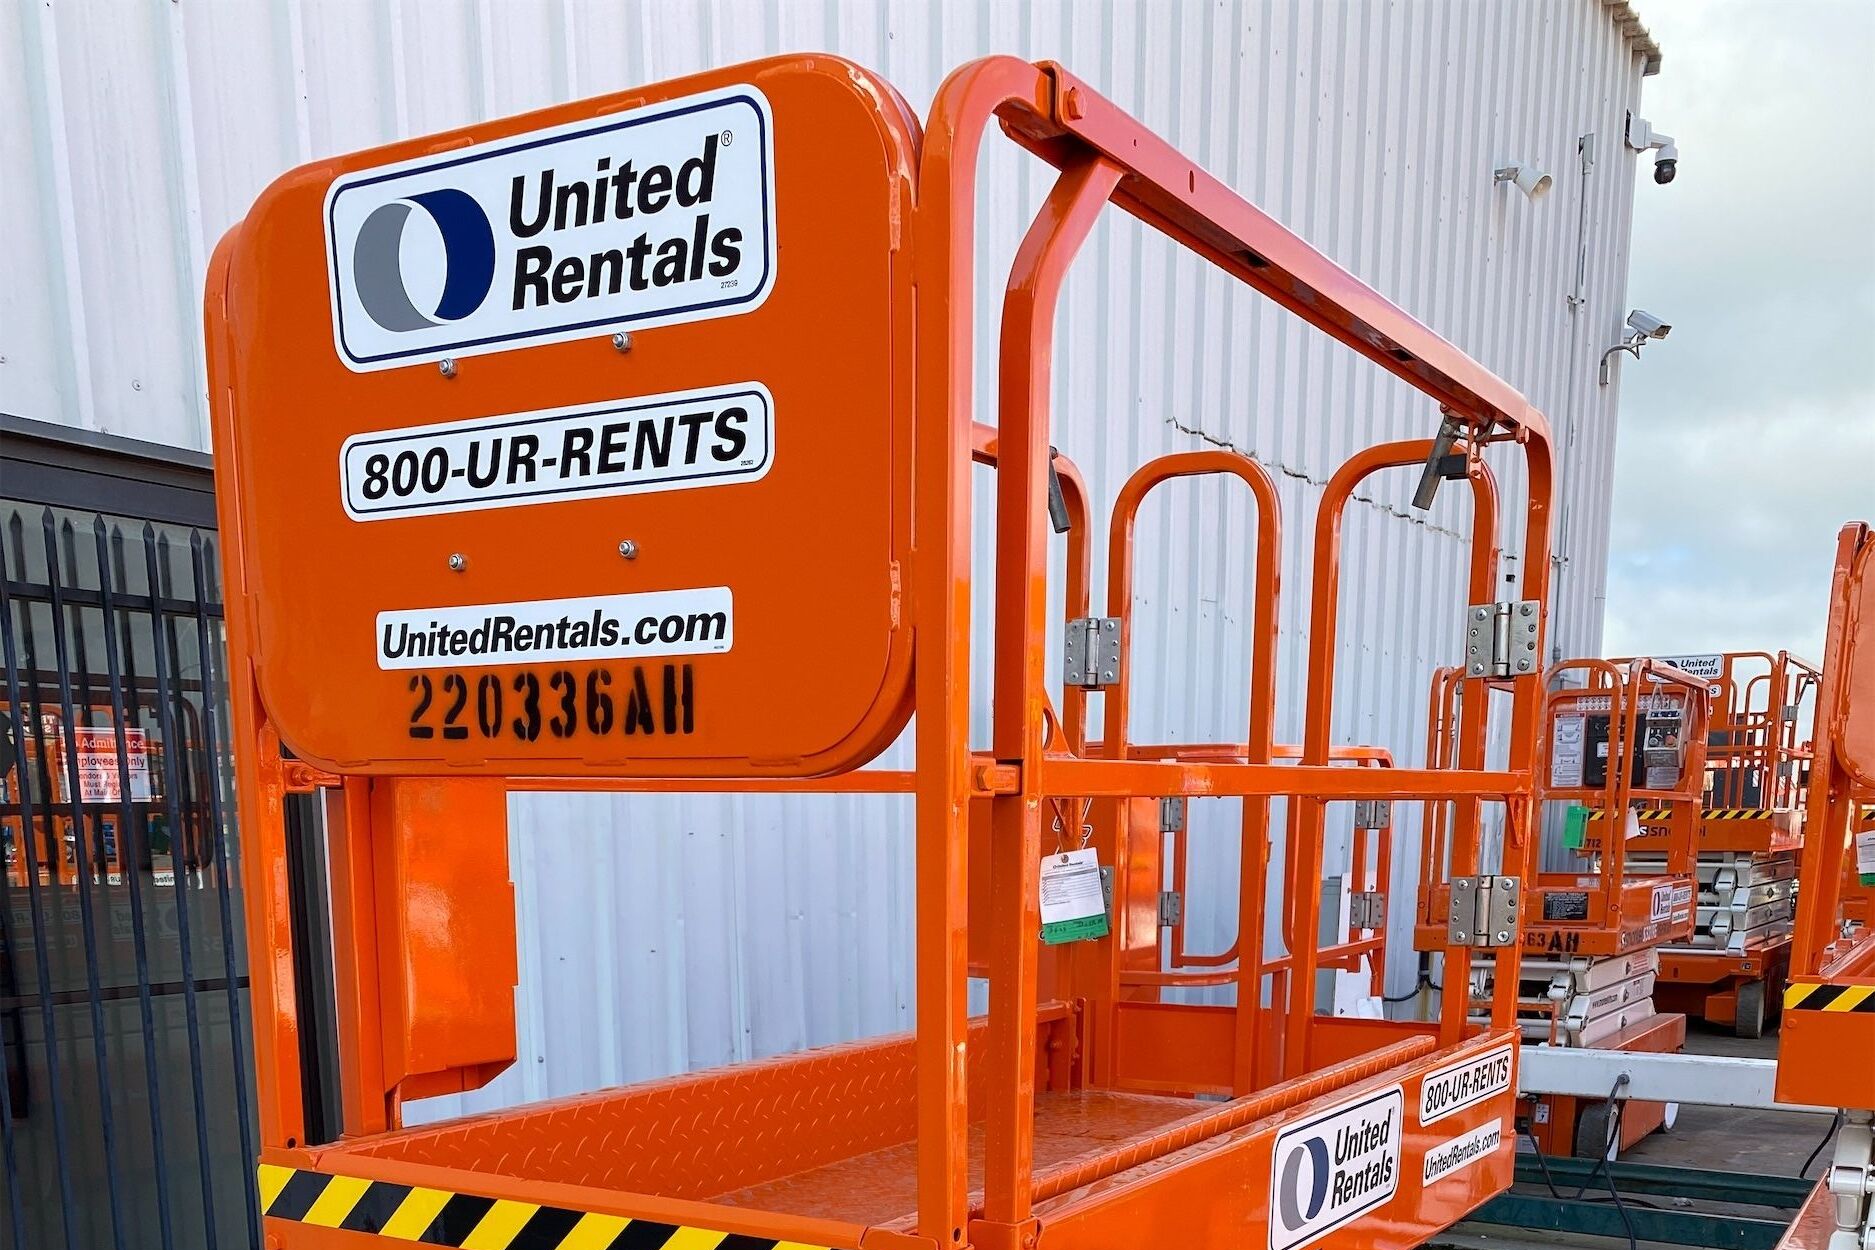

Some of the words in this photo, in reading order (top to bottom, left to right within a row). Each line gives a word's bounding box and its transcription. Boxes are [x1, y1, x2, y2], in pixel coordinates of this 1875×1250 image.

[508, 133, 720, 239] United
[511, 214, 742, 311] Rentals
[360, 406, 750, 501] 800-UR-RENTS
[382, 607, 727, 660] UnitedRentals.com
[1680, 658, 1716, 667] United
[1425, 1055, 1509, 1114] 800-UR-RENTS
[1334, 1108, 1392, 1166] United
[1424, 1129, 1499, 1180] UnitedRentals.com
[1331, 1149, 1393, 1209] Rentals
